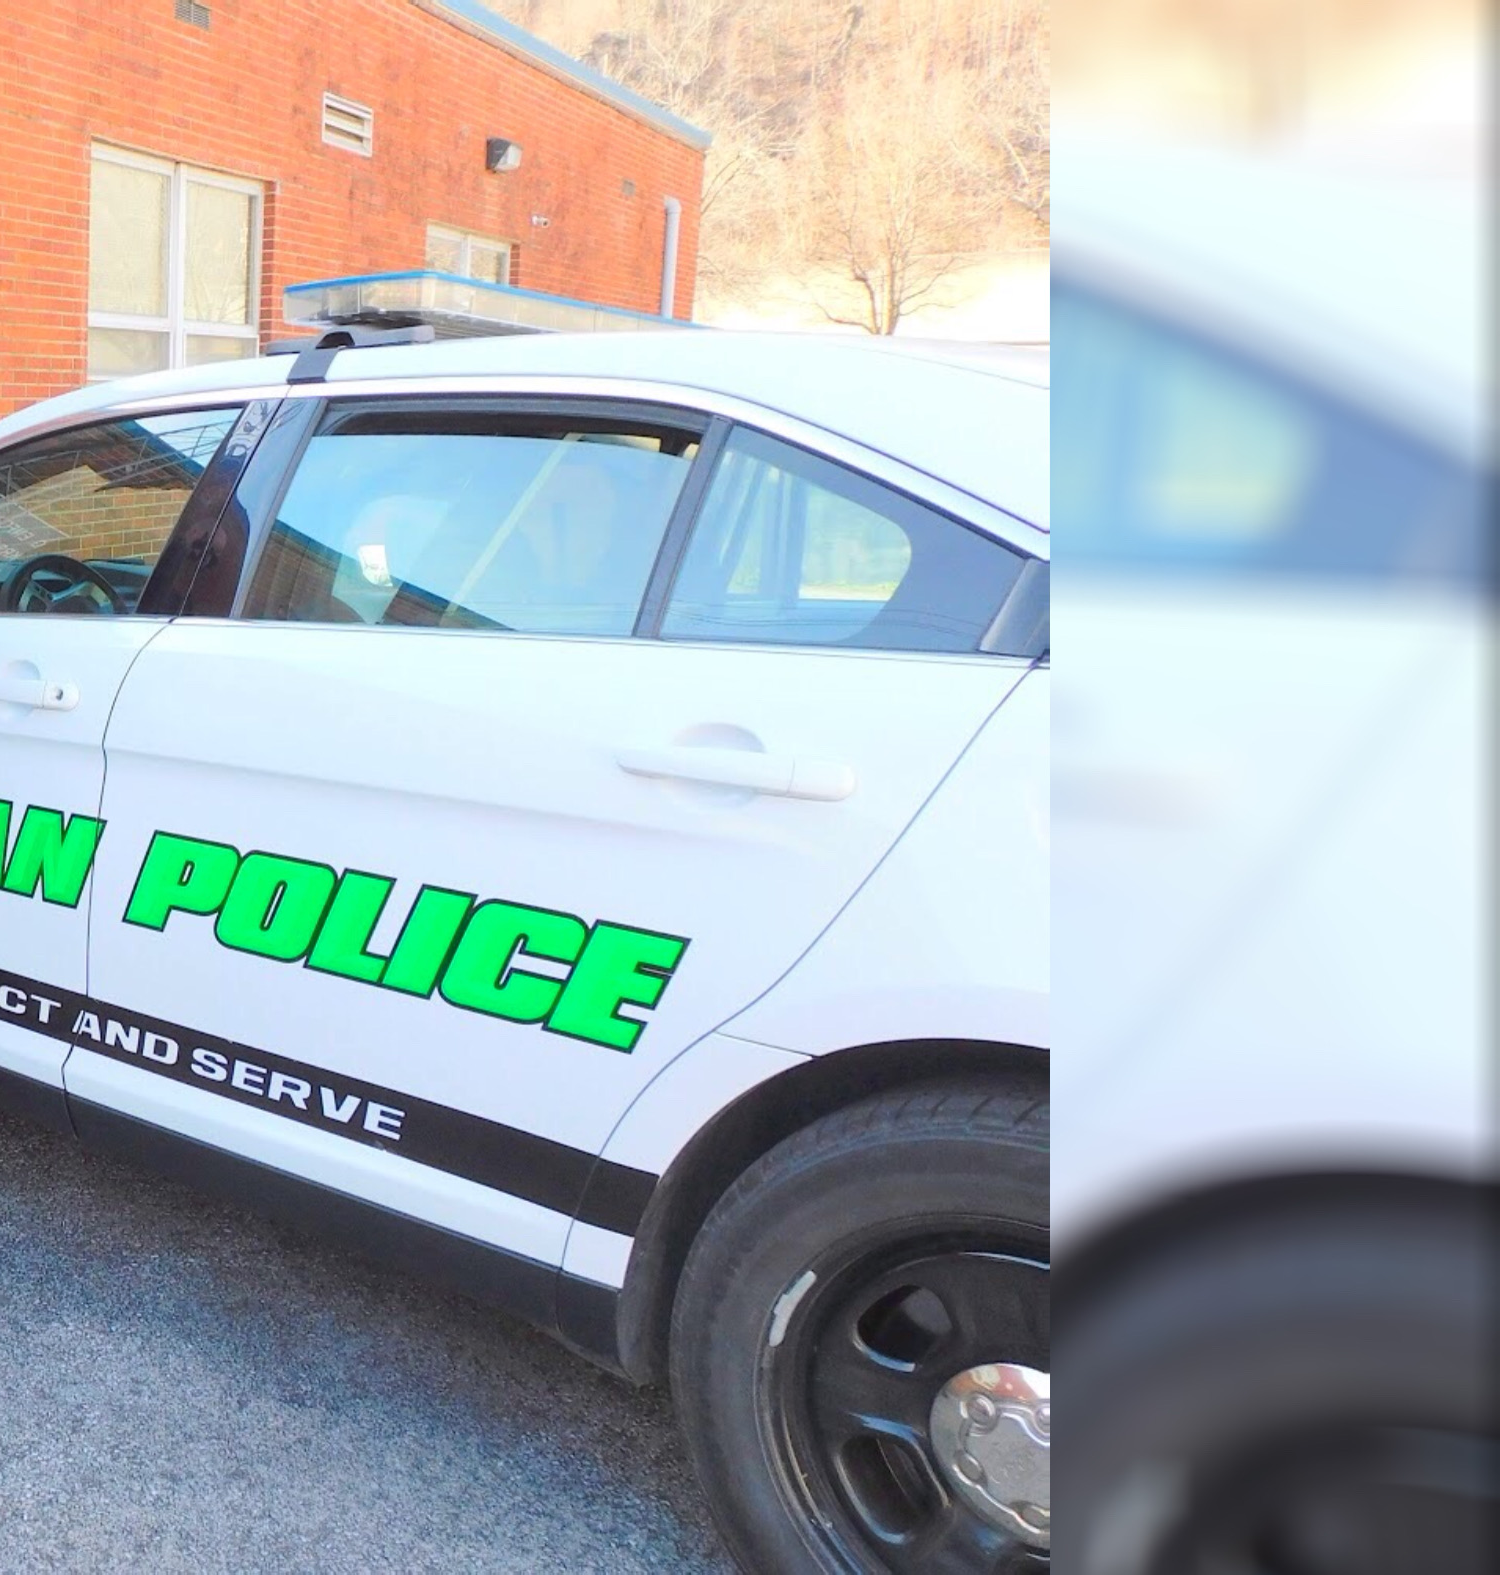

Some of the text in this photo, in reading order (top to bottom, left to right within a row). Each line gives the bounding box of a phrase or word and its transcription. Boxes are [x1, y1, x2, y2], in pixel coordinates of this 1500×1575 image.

[123, 829, 692, 1054] POLICE
[72, 1009, 180, 1066] AND
[190, 1048, 407, 1142] SERVE
